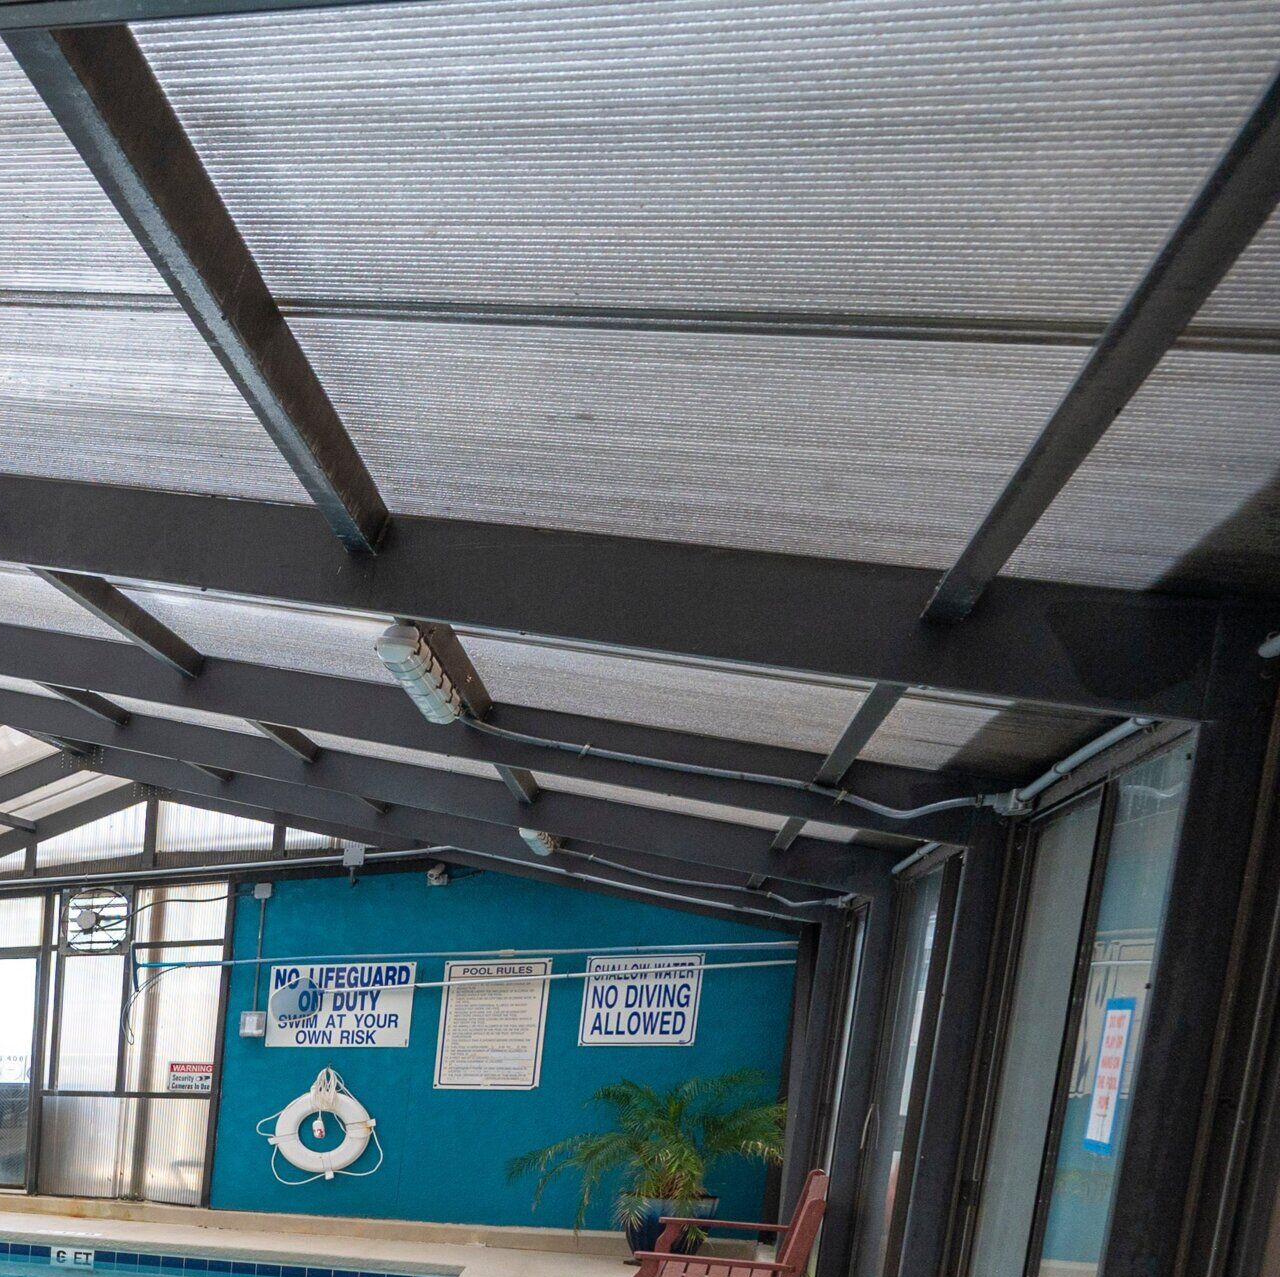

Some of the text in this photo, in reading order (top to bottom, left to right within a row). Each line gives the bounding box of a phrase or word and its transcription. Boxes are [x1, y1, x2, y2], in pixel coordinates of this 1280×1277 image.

[275, 965, 411, 989] NO LIFEGUARD
[462, 966, 533, 975] POOL RULES
[593, 962, 695, 981] SHALLOW WATER
[298, 990, 381, 1012] ON DUTY
[592, 983, 691, 1009] NO DIVING
[278, 1013, 399, 1029] SWIM AT YOUR
[590, 1011, 686, 1035] ALLOWED
[295, 1030, 377, 1045] OWN RISK
[172, 1064, 213, 1072] WARNING
[171, 1082, 193, 1090] Cameras
[172, 1074, 195, 1082] Security
